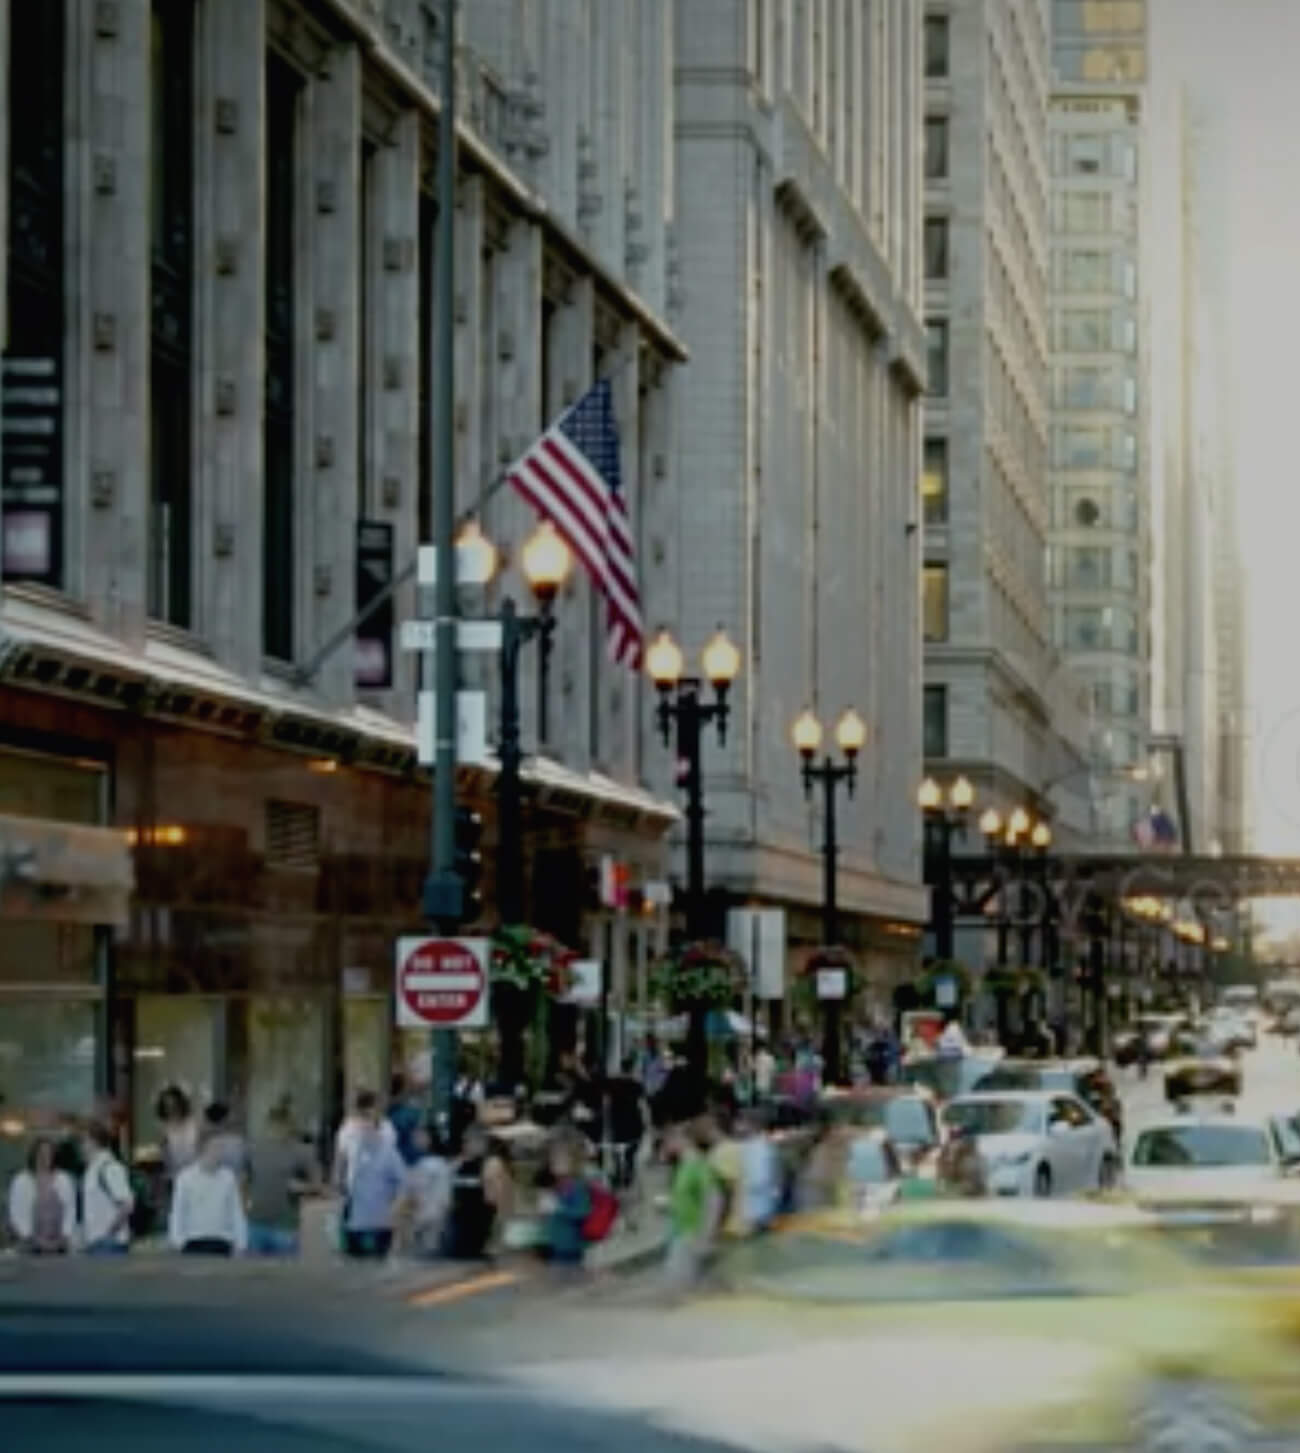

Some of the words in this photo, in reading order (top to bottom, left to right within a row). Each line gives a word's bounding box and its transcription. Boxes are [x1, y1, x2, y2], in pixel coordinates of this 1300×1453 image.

[411, 956, 434, 970] DO
[440, 956, 473, 970] NOT
[417, 993, 467, 1008] ENTER
